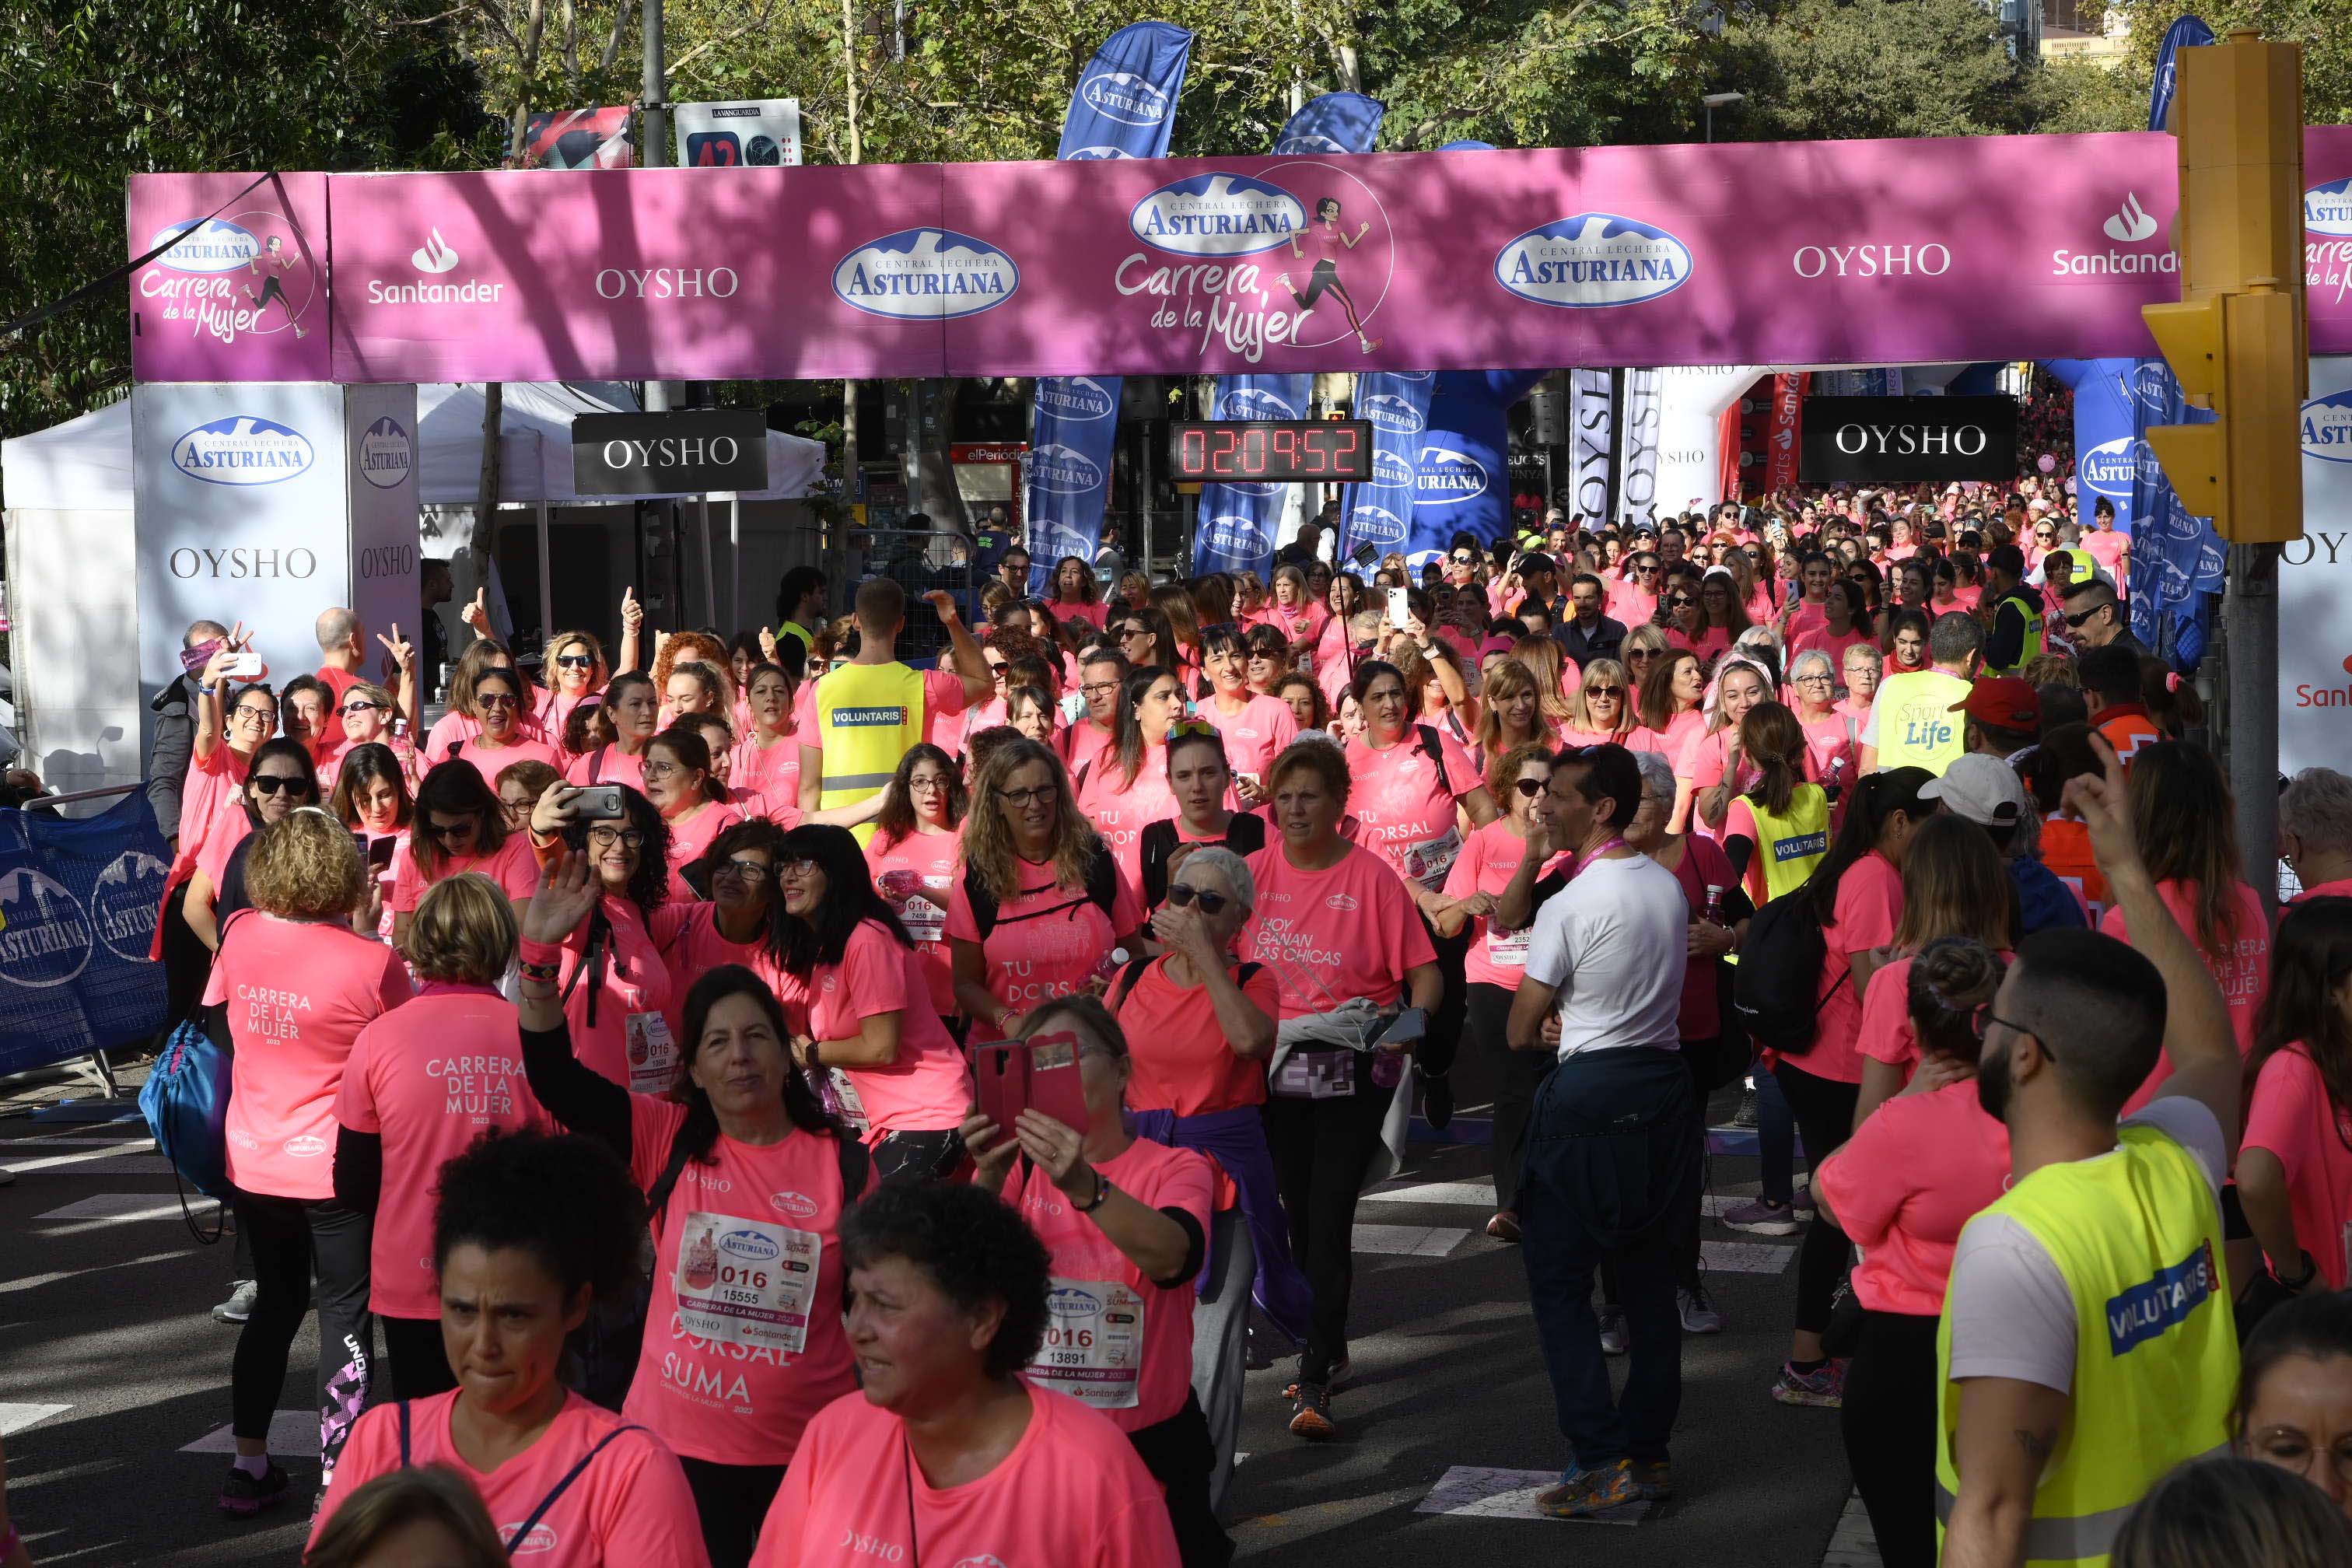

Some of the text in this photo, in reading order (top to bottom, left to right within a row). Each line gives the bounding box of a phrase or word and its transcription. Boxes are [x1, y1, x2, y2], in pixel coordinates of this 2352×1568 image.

[1088, 82, 1163, 119] ASTURIANA
[1170, 199, 1287, 211] CENTRAL LECHERA
[1143, 205, 1293, 236] ASTURIANA
[1539, 243, 1671, 257] CENTRAL LECHERA
[1792, 243, 1951, 278] OYSHO
[2305, 241, 2352, 264] arre
[876, 257, 999, 269] CENTRAL LECHERA
[1509, 249, 1678, 285] ASTURIANA
[2053, 248, 2181, 276] Santand
[140, 269, 232, 299] Carrera
[595, 268, 738, 299] OYSHO
[847, 262, 1005, 296] ASTURIANA
[1115, 253, 1261, 296] Carrera
[2325, 268, 2339, 286] la
[368, 279, 504, 304] Santander
[163, 295, 266, 343] de la Mujer
[1150, 290, 1315, 364] de la Mujer
[1035, 383, 1104, 414] ASTURIANA
[204, 439, 299, 448] CENTRAL LECHERA
[1579, 368, 1612, 519] OYSH
[1626, 368, 1660, 506] OYSH
[1836, 423, 1986, 456] OYSHO
[183, 441, 304, 468] ASTURIANA
[363, 443, 408, 471] ASTURIANA
[603, 436, 739, 469] OYSHO
[968, 449, 1020, 461] elPeriódi
[1182, 429, 1356, 474] 02:09:52
[1657, 450, 1705, 465] YSHO
[2099, 457, 2134, 465] CENTRA
[1373, 467, 1409, 484] URIANA
[1774, 453, 1791, 488] orts
[2086, 455, 2134, 482] ASTU
[1417, 474, 1481, 491] URIANA
[361, 544, 413, 579] OYSHO
[1030, 541, 1085, 560] TURIANA
[170, 547, 317, 579] OYSHO
[833, 711, 900, 723] VOLUNTARIS
[1904, 720, 1951, 751] Life
[1100, 810, 1119, 825] TU
[1357, 810, 1377, 824] TU
[908, 901, 933, 912] 016
[1260, 917, 1294, 932] HOY
[1257, 931, 1314, 948] GANAN
[1253, 945, 1342, 966] LAS CHICAS
[1002, 960, 1031, 978] TU
[2240, 958, 2257, 976] LA
[237, 984, 312, 1011] CARRERA
[1008, 981, 1070, 1003] DORS
[250, 1002, 296, 1024] DE LA
[246, 1019, 300, 1041] MUJER
[649, 1042, 670, 1056] 016
[425, 1055, 528, 1078] CARRERA
[447, 1075, 510, 1095] DE LA
[445, 1095, 513, 1115] MUJER
[723, 1237, 775, 1257] ASTURIANA
[720, 1265, 768, 1290] 016
[723, 1289, 759, 1305] 15555
[686, 1300, 723, 1314] CARRERA
[723, 1305, 734, 1315] DE
[736, 1307, 747, 1317] LA
[747, 1309, 775, 1321] MUJER
[684, 1315, 797, 1342] OYSHO Santander
[1047, 1328, 1094, 1348] 016
[1049, 1352, 1087, 1365] 13891
[661, 1350, 751, 1404] SUMA
[1025, 1366, 1050, 1377] ARRERA
[1052, 1367, 1065, 1377] DE
[1065, 1368, 1076, 1377] LA
[1076, 1370, 1105, 1379] MUJER
[1083, 1387, 1128, 1398] Santander
